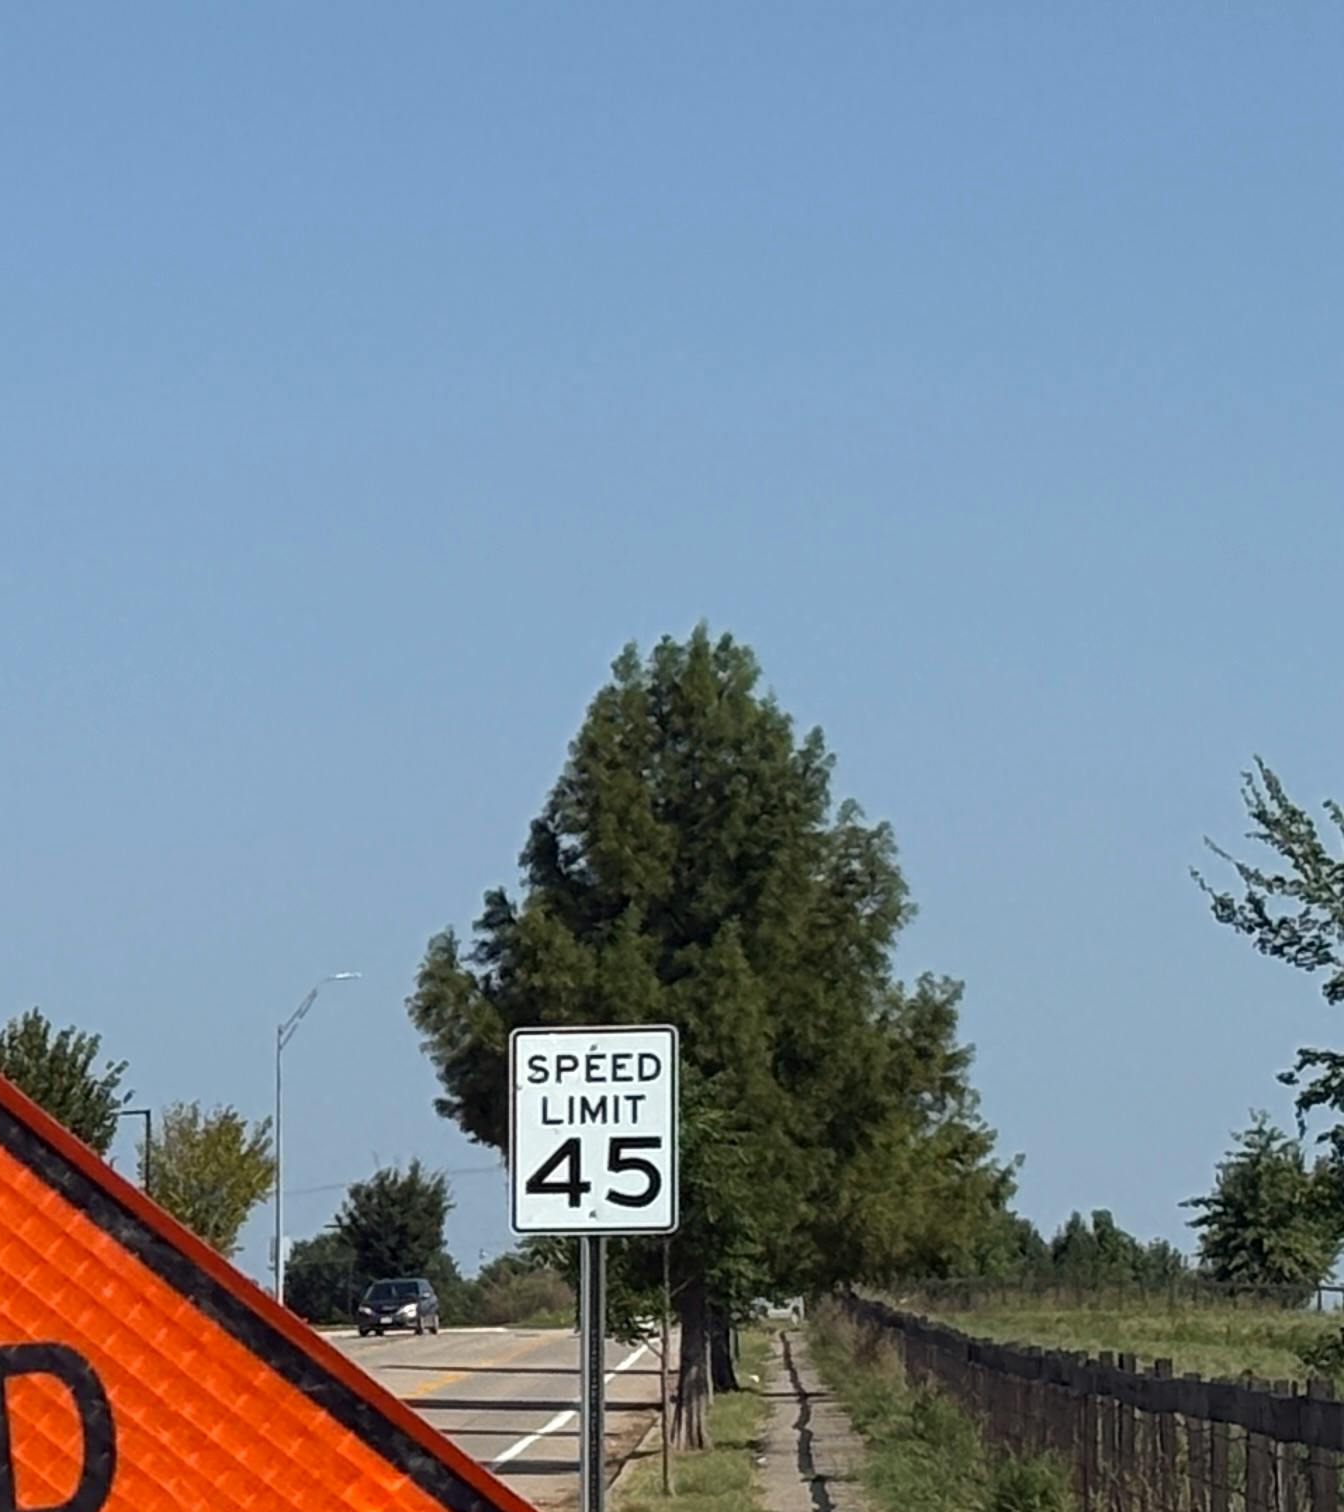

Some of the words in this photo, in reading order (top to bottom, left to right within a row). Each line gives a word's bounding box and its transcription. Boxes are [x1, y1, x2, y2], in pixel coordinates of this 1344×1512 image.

[527, 1053, 662, 1084] SPEED
[542, 1094, 646, 1125] LIMIT
[525, 1136, 662, 1208] 45
